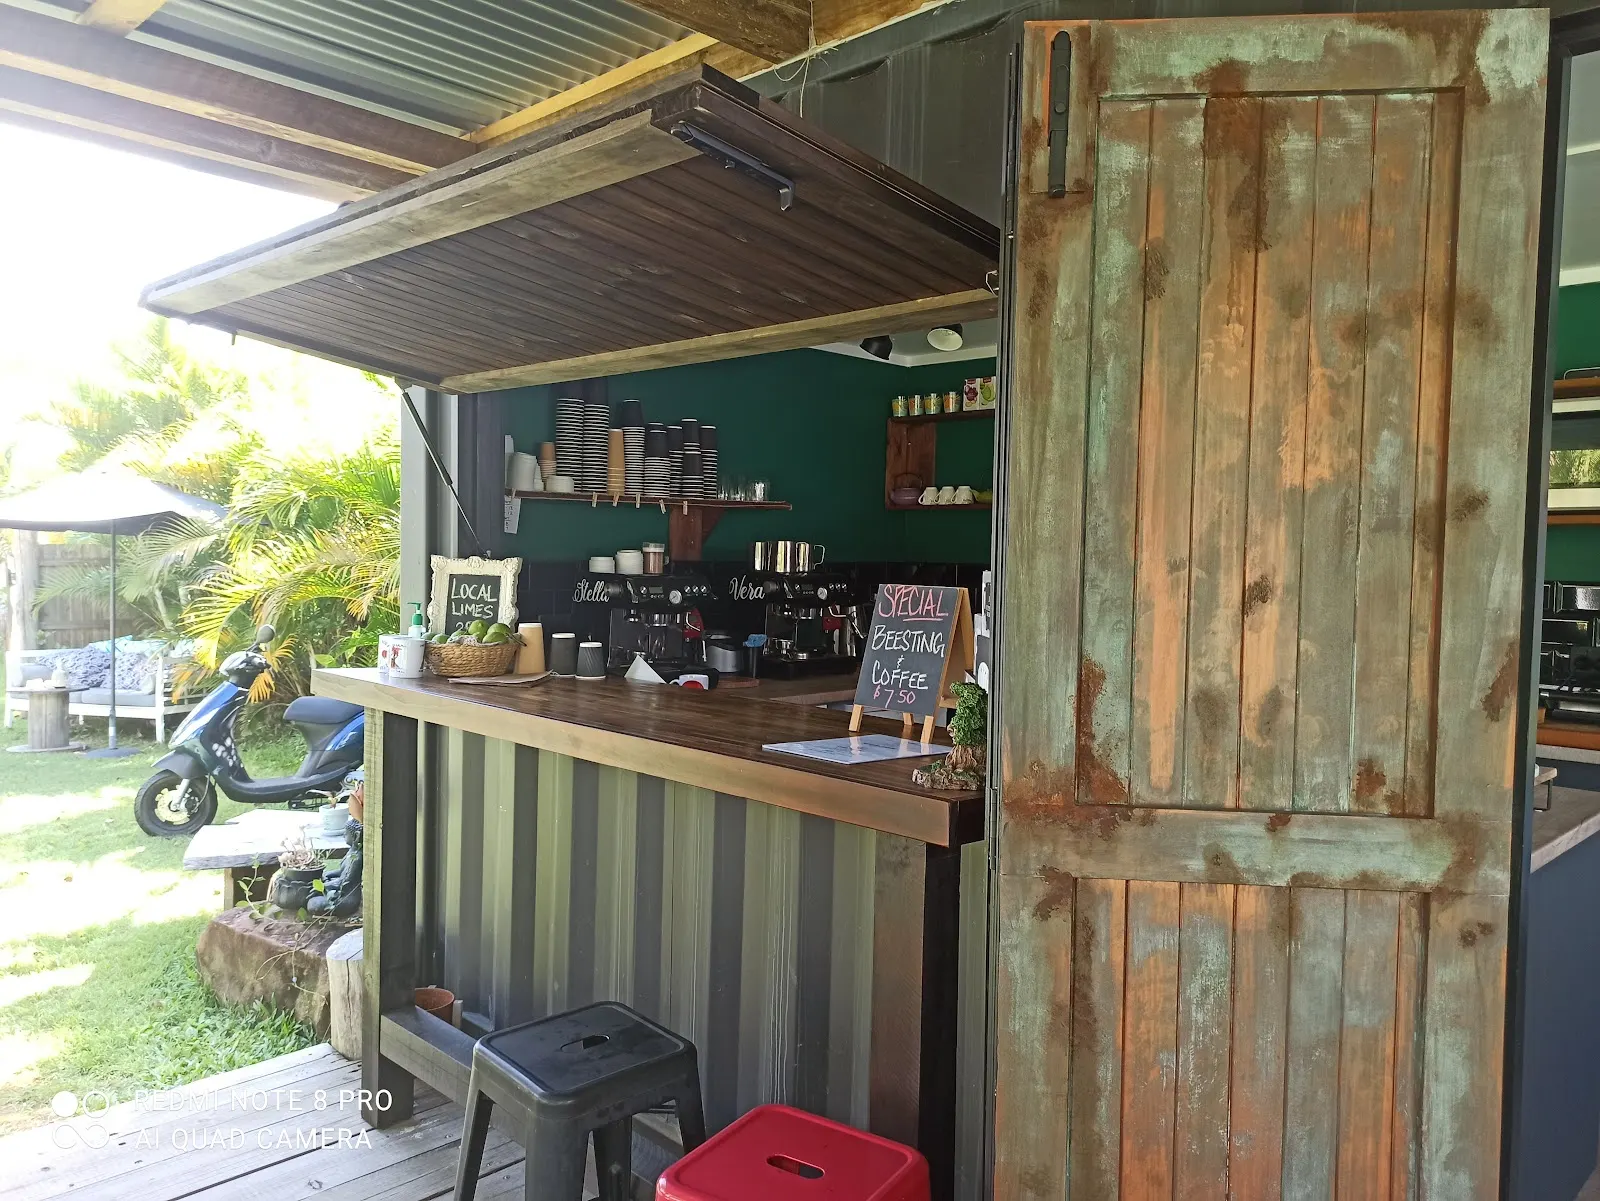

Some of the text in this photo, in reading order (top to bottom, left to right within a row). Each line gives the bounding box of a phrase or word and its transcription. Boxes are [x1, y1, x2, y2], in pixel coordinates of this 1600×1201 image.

[451, 578, 497, 602] LOCAL
[729, 575, 766, 600] Vera
[878, 584, 949, 619] SPECIAL
[451, 601, 494, 619] LIMES
[871, 624, 945, 658] BEESTING
[871, 659, 929, 690] COFFEE
